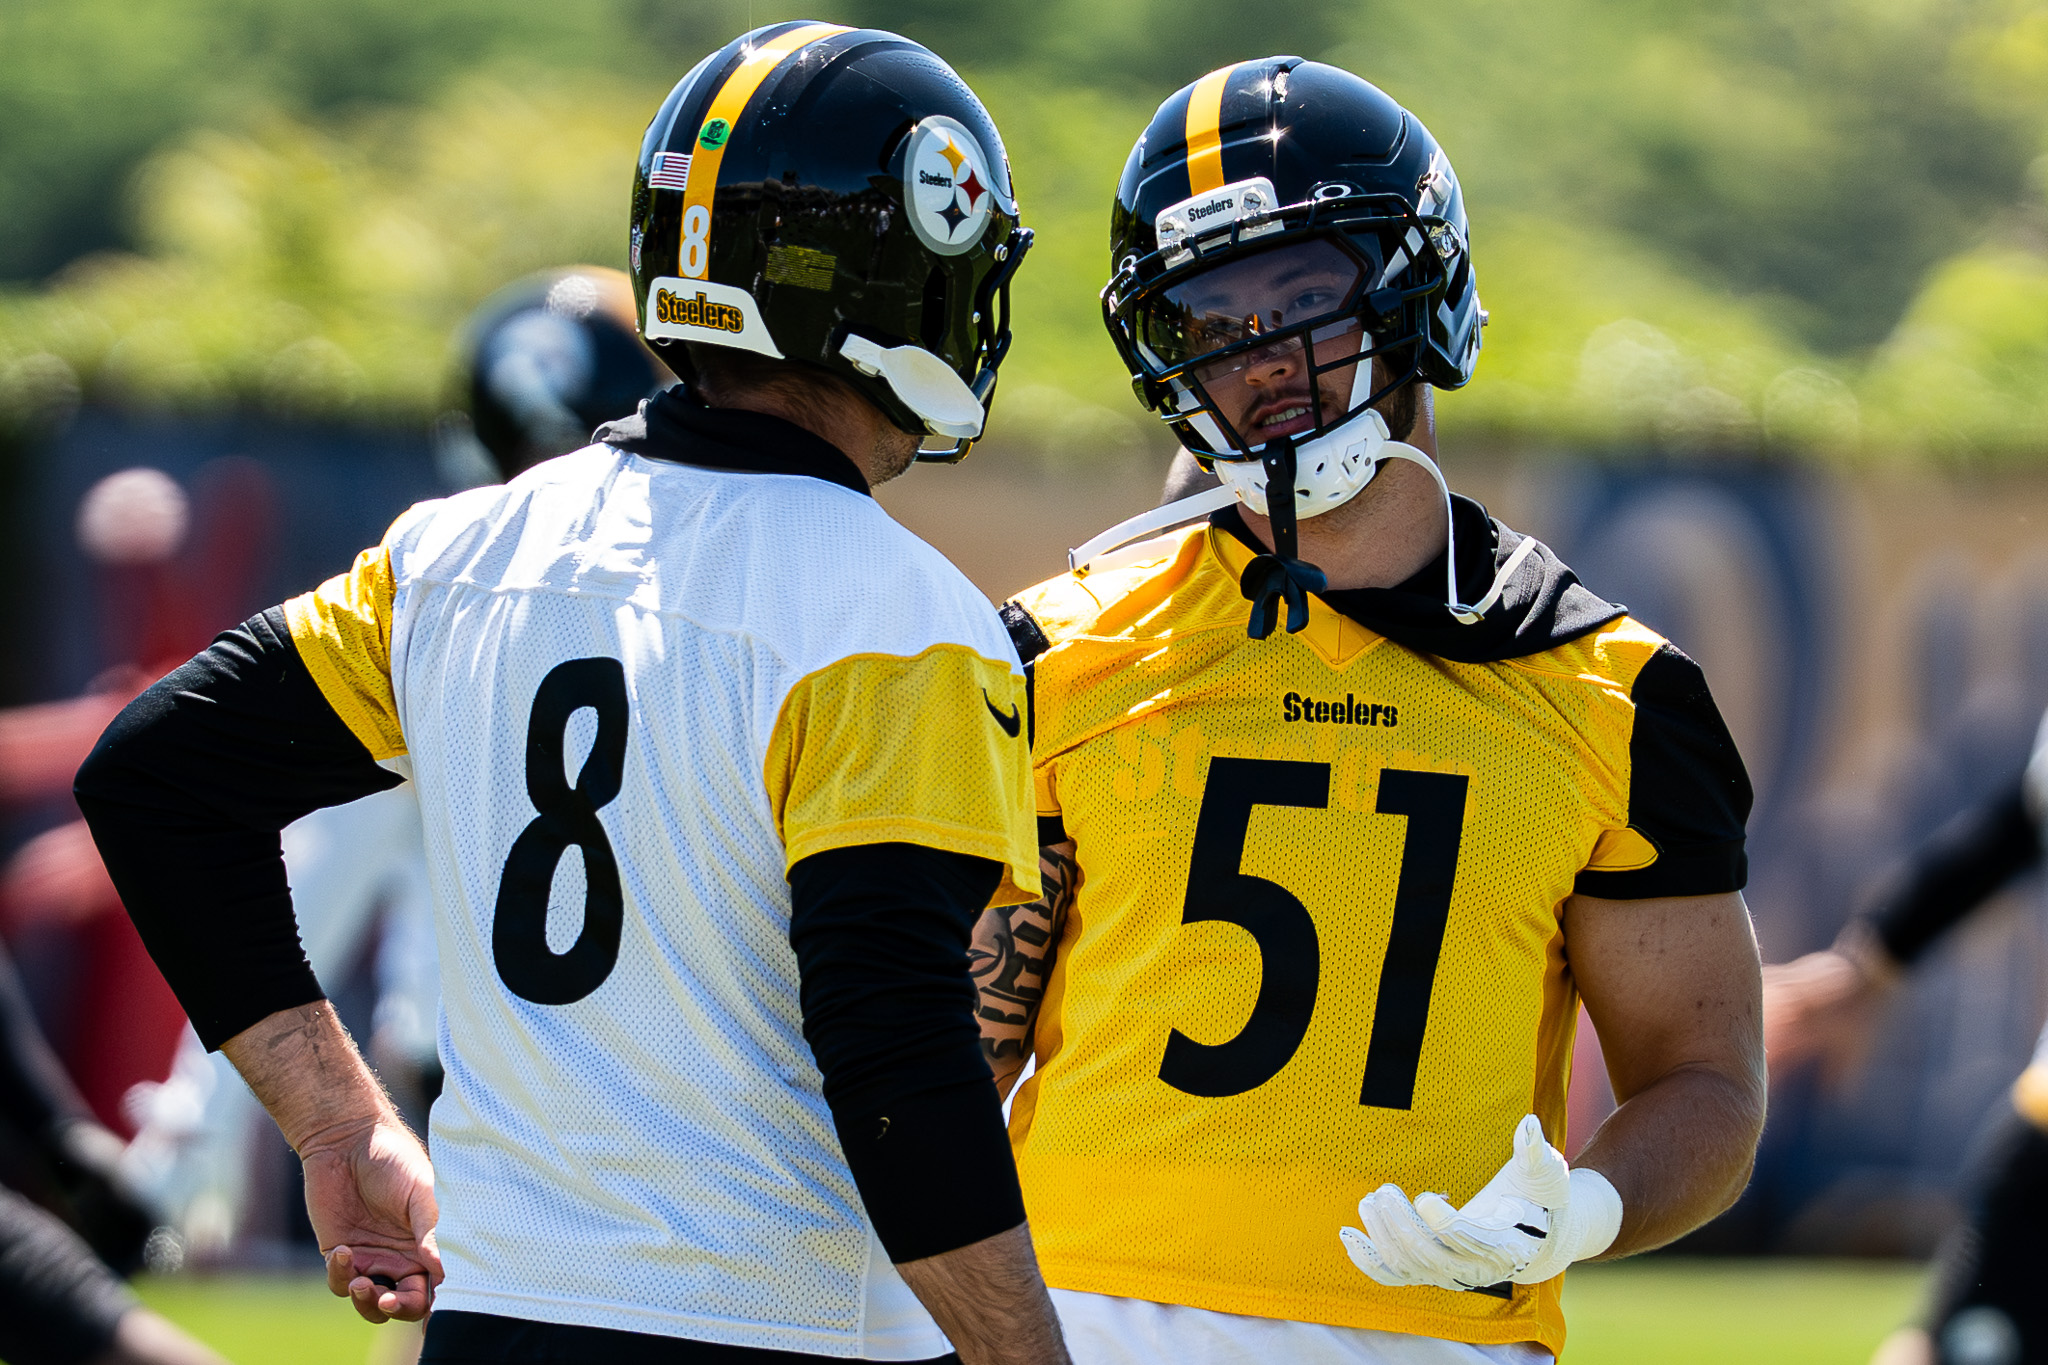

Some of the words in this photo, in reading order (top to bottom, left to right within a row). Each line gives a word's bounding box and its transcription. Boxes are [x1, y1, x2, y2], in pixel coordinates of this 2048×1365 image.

[919, 169, 953, 188] Steelers
[1188, 198, 1234, 222] Steelers
[680, 204, 711, 278] 8
[657, 287, 744, 334] Steelers
[1283, 691, 1399, 728] Steelers
[493, 657, 629, 1006] 8
[1158, 756, 1469, 1111] 51
